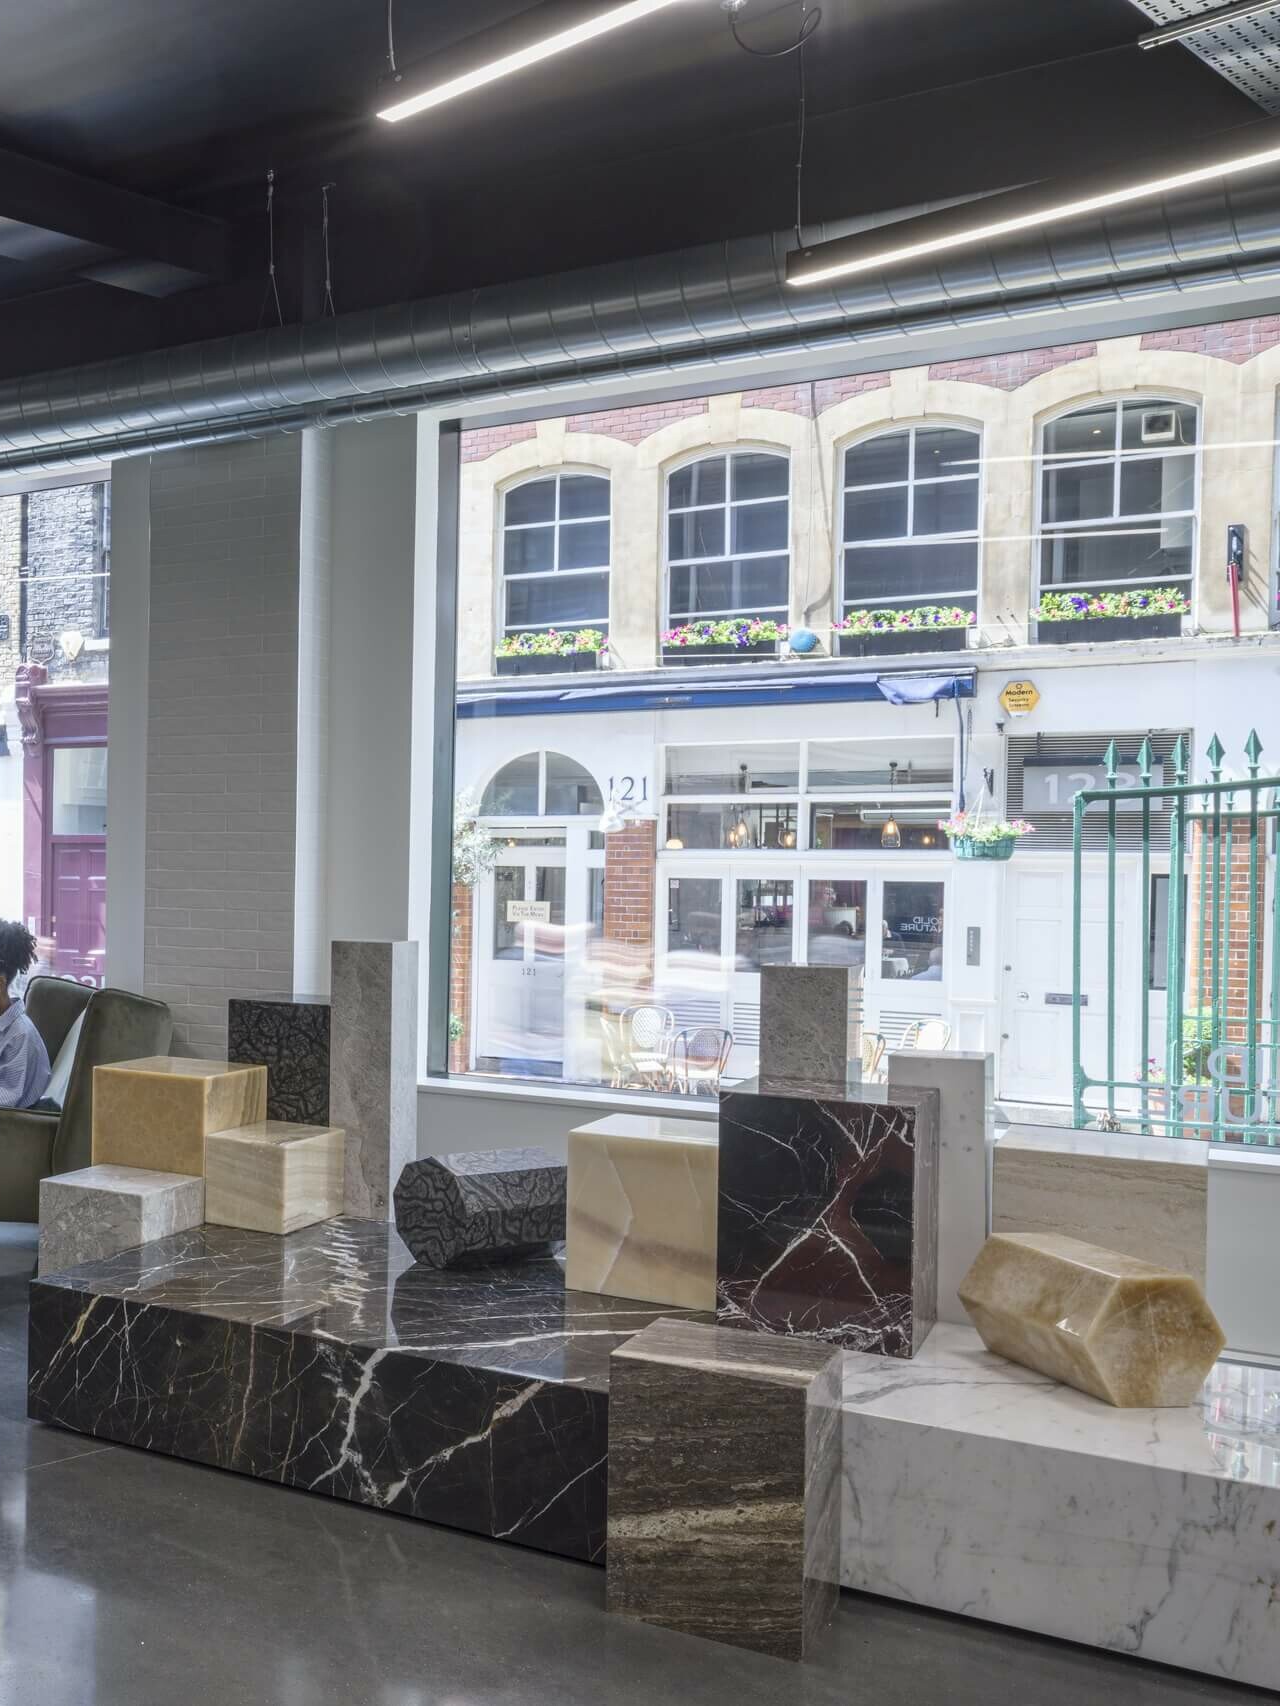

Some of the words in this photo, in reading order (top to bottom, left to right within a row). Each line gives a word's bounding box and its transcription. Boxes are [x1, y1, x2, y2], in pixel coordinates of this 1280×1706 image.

[1005, 689, 1033, 697] Modern
[608, 776, 648, 801] 121
[521, 967, 536, 977] 121
